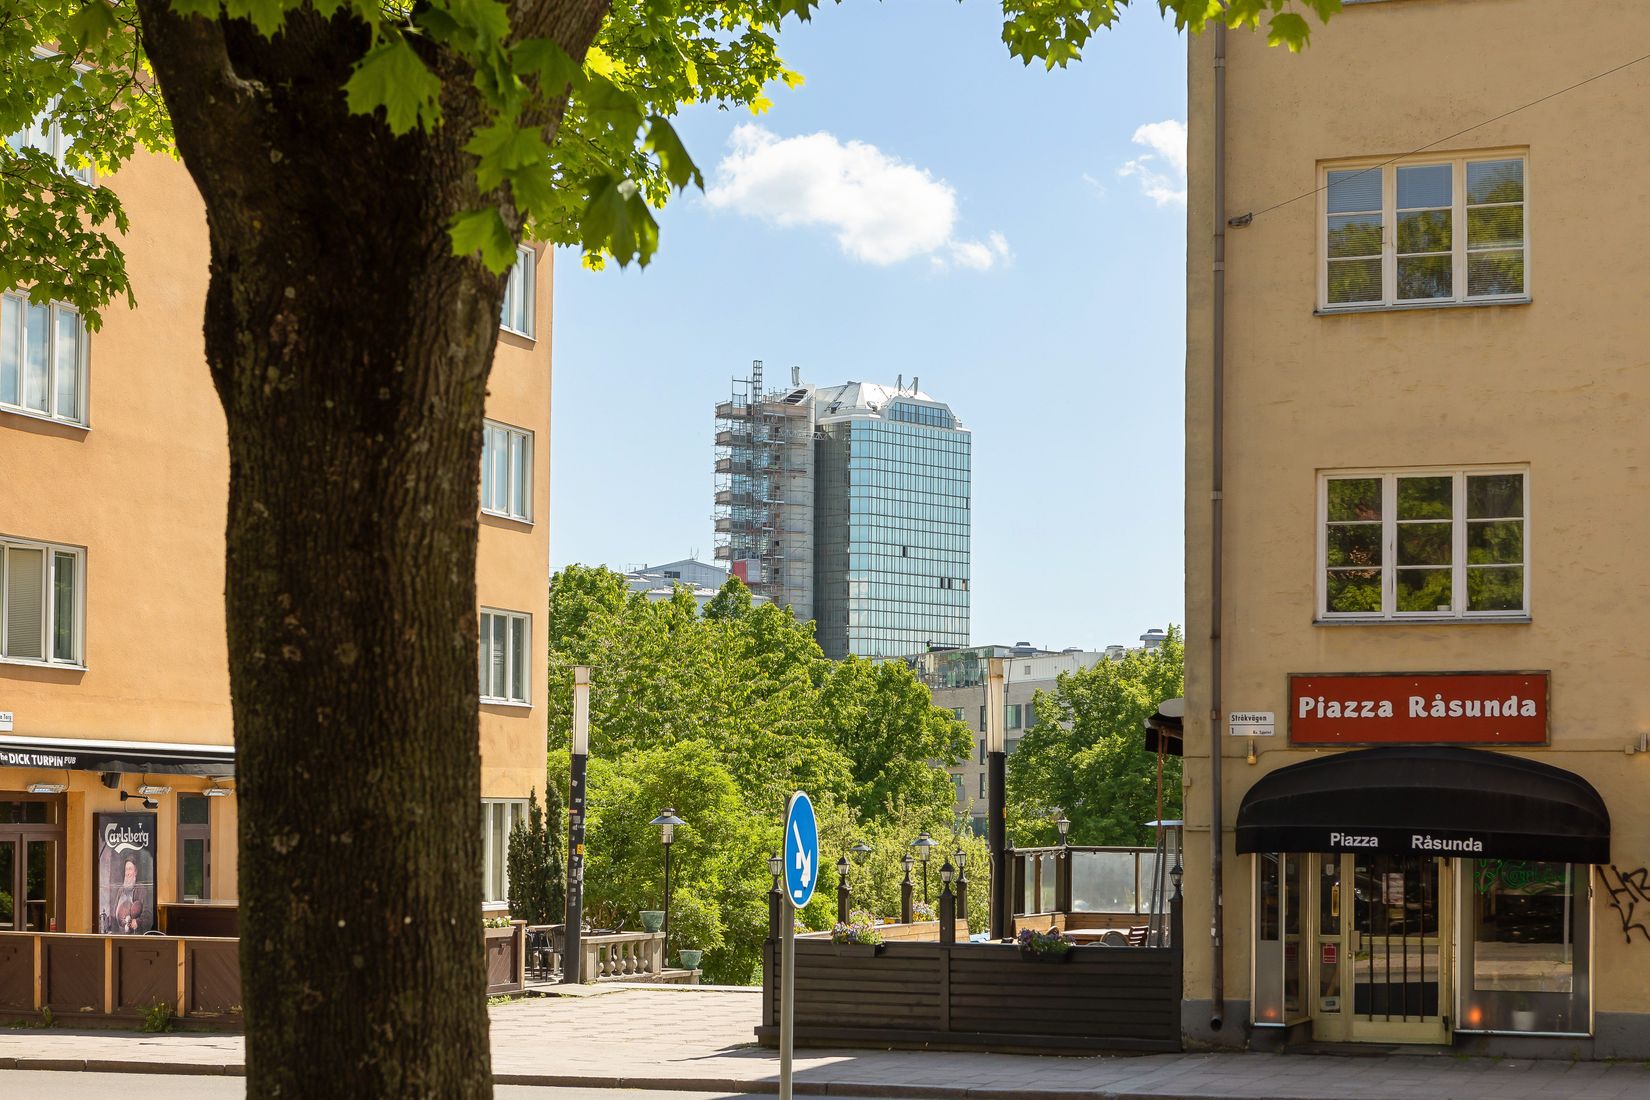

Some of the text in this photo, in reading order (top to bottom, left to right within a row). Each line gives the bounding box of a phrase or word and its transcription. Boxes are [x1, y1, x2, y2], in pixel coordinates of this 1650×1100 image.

[1298, 693, 1538, 719] Piazza Råsunda
[1231, 714, 1267, 723] Stråkvägen
[8, 753, 31, 765] DICK
[31, 754, 64, 767] TURPIN
[63, 756, 77, 765] PUB
[104, 823, 150, 850] Carlsberg
[1330, 832, 1483, 852] Piazza Råsunda
